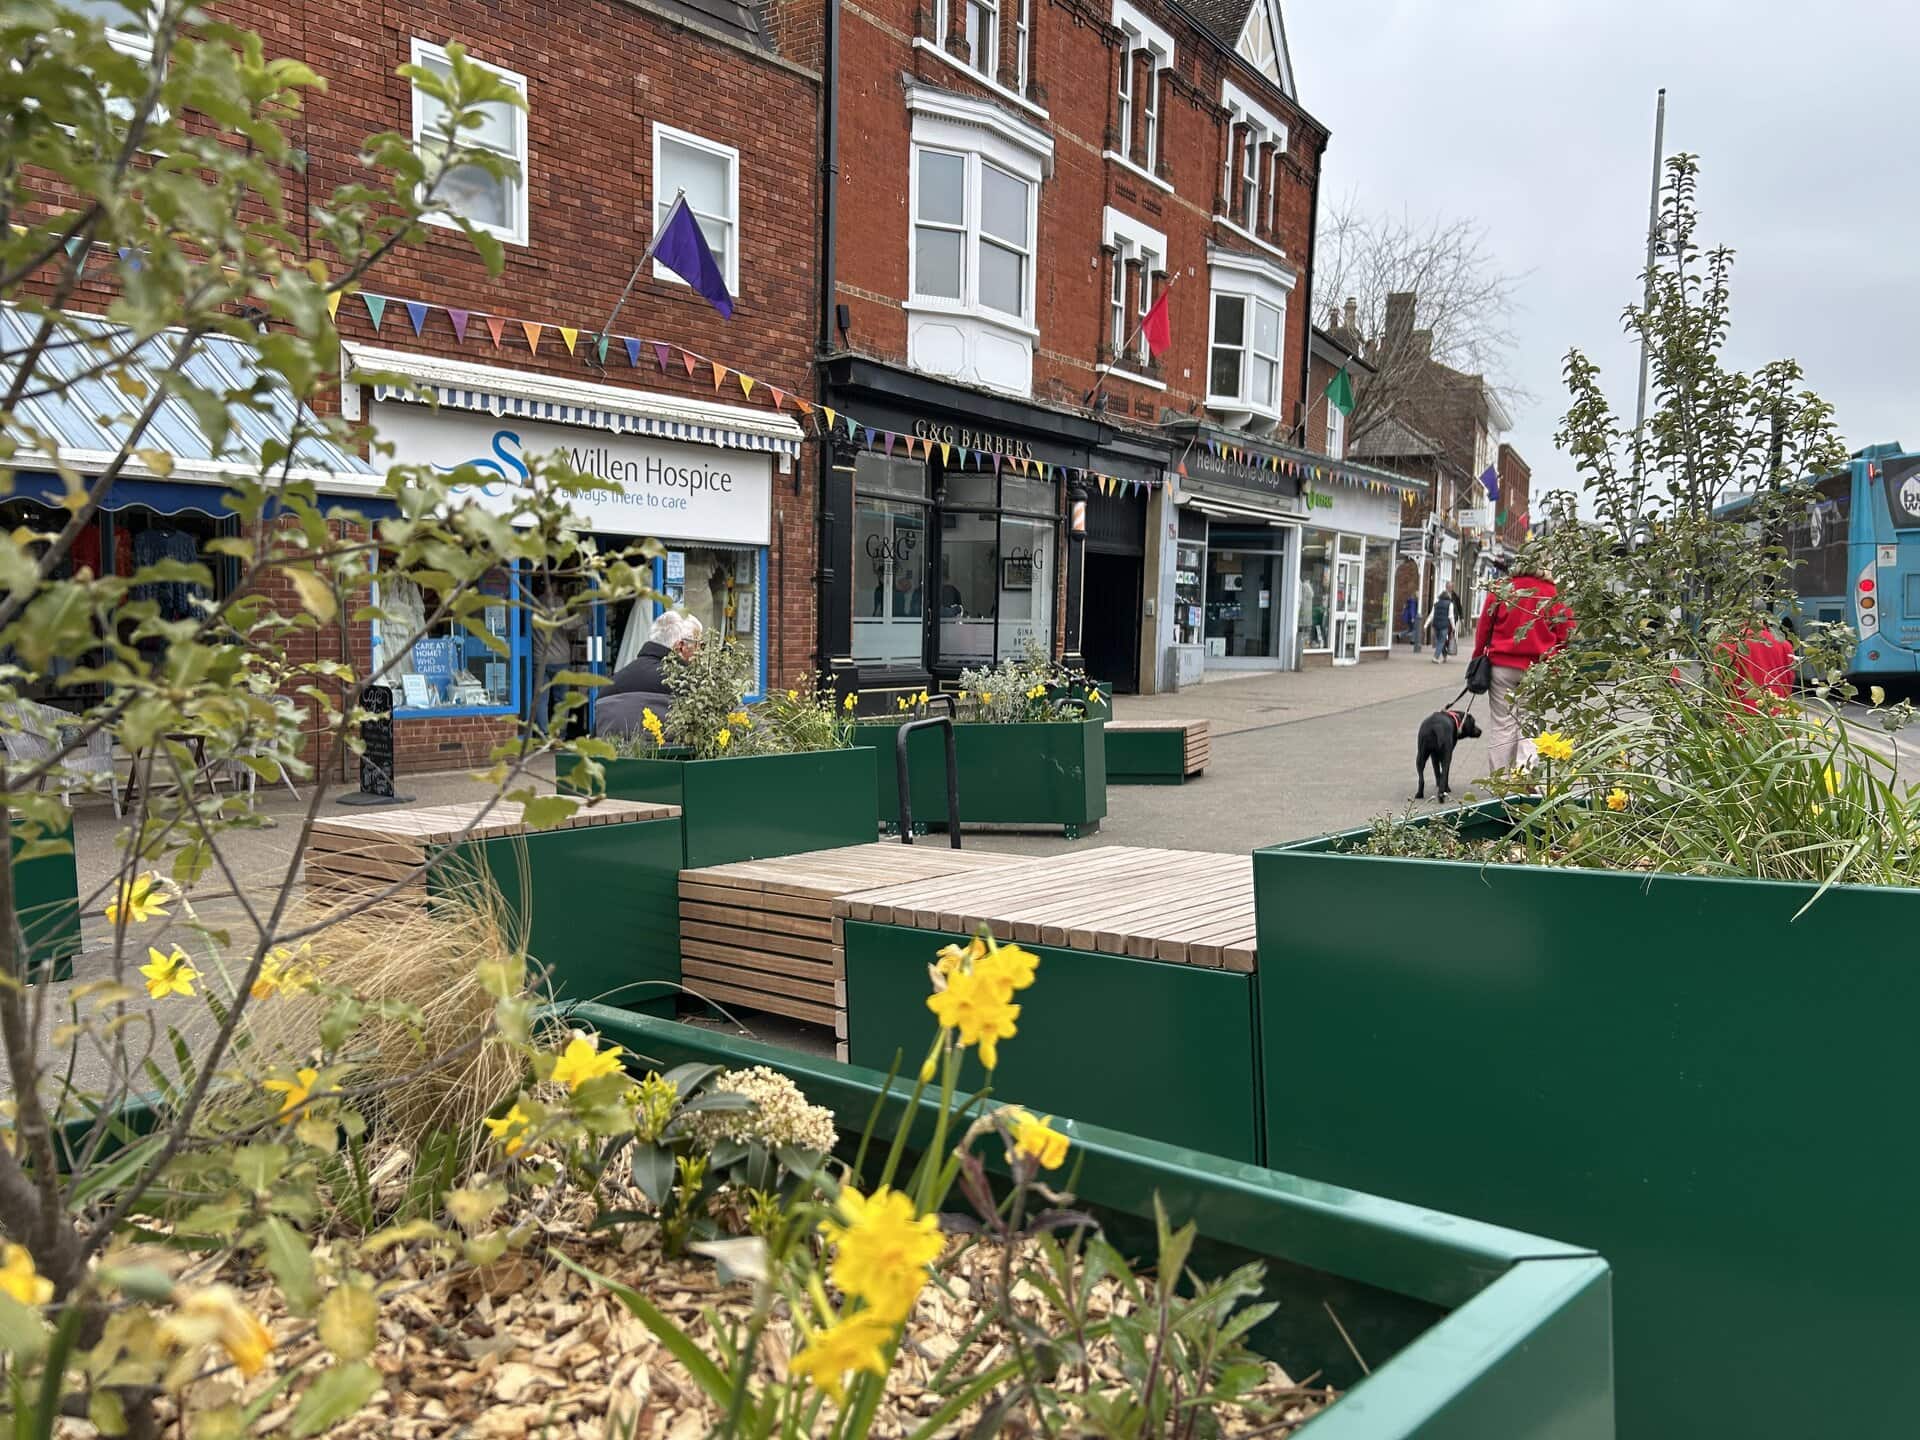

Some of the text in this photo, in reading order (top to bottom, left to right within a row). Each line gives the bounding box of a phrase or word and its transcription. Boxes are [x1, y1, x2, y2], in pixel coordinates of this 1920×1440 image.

[916, 419, 1033, 459] G&G BARBERS
[561, 446, 732, 497] Willen Hospice
[562, 487, 607, 506] aways
[647, 493, 659, 507] to
[661, 497, 687, 510] care
[865, 534, 910, 561] G&G
